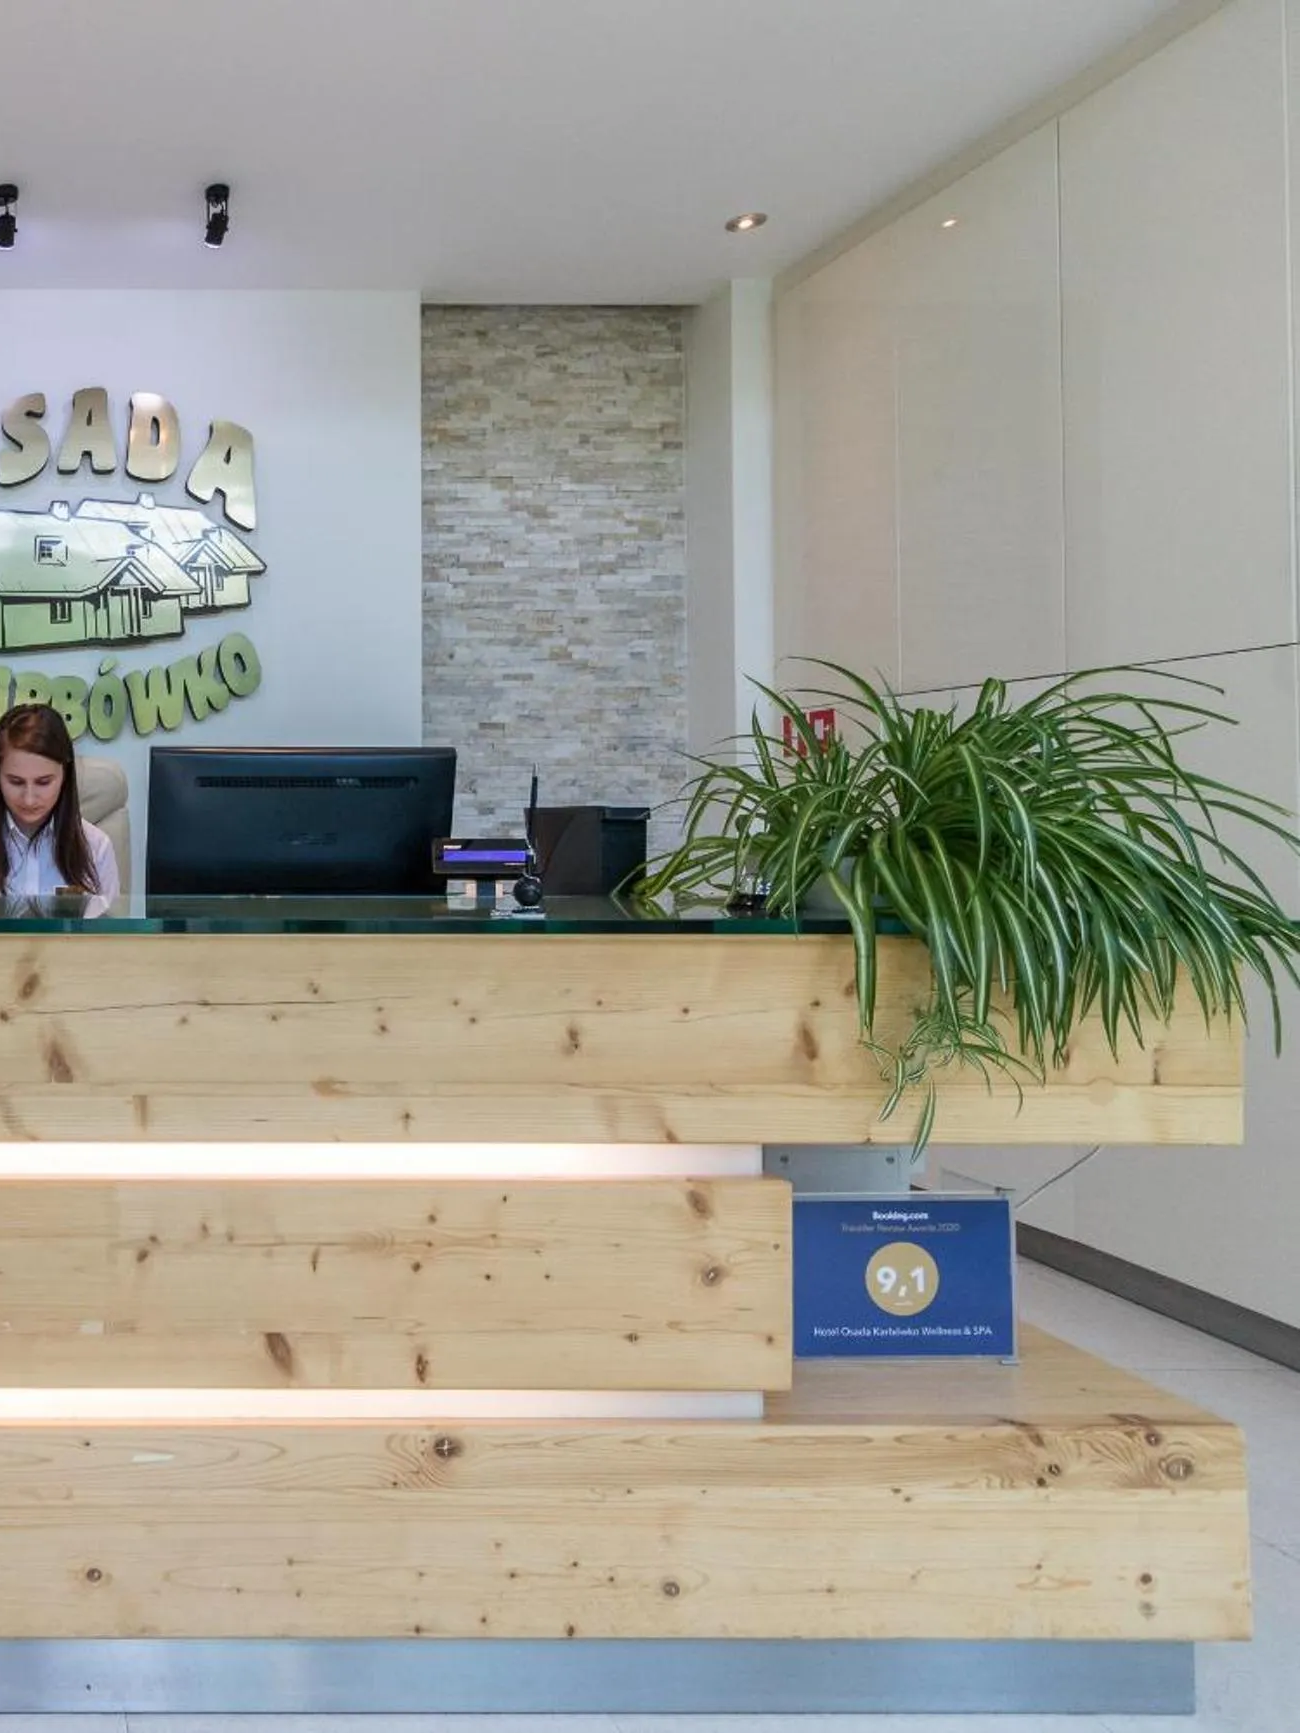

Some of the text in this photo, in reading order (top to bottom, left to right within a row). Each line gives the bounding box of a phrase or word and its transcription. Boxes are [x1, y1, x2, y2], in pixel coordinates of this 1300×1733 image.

[872, 1211, 928, 1223] Booking.com
[877, 1265, 925, 1297] 9,1
[814, 1326, 839, 1336] Hotel
[841, 1326, 871, 1336] Osada
[921, 1326, 962, 1336] Wellness
[964, 1326, 972, 1336] &
[973, 1325, 993, 1336] SPA
